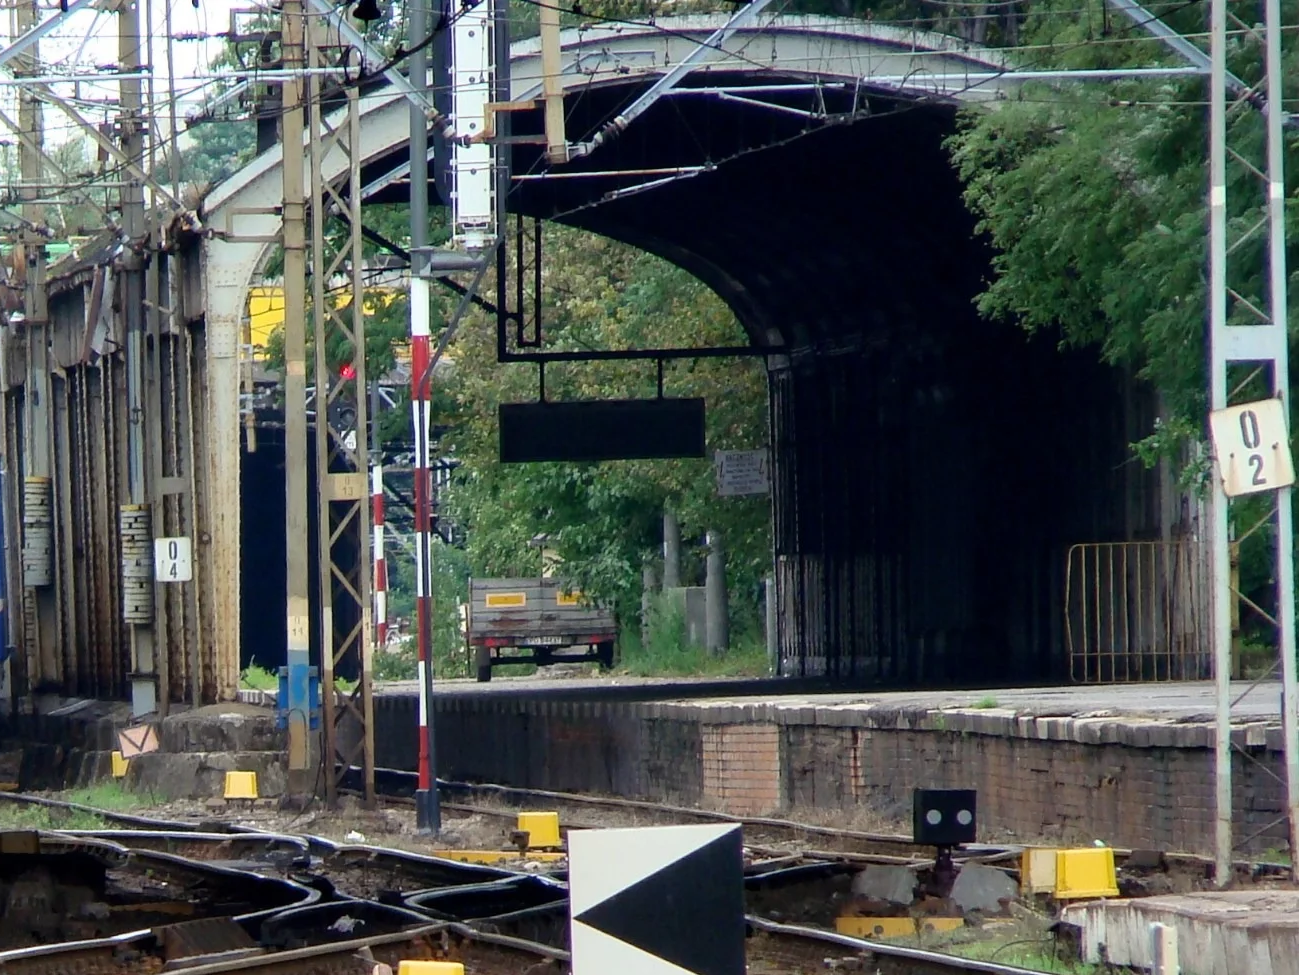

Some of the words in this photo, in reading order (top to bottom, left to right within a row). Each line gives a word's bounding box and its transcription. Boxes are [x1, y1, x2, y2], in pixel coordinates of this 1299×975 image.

[1239, 410, 1261, 449] 0
[1248, 454, 1267, 486] 2
[168, 540, 178, 561] 0
[169, 562, 177, 579] 4
